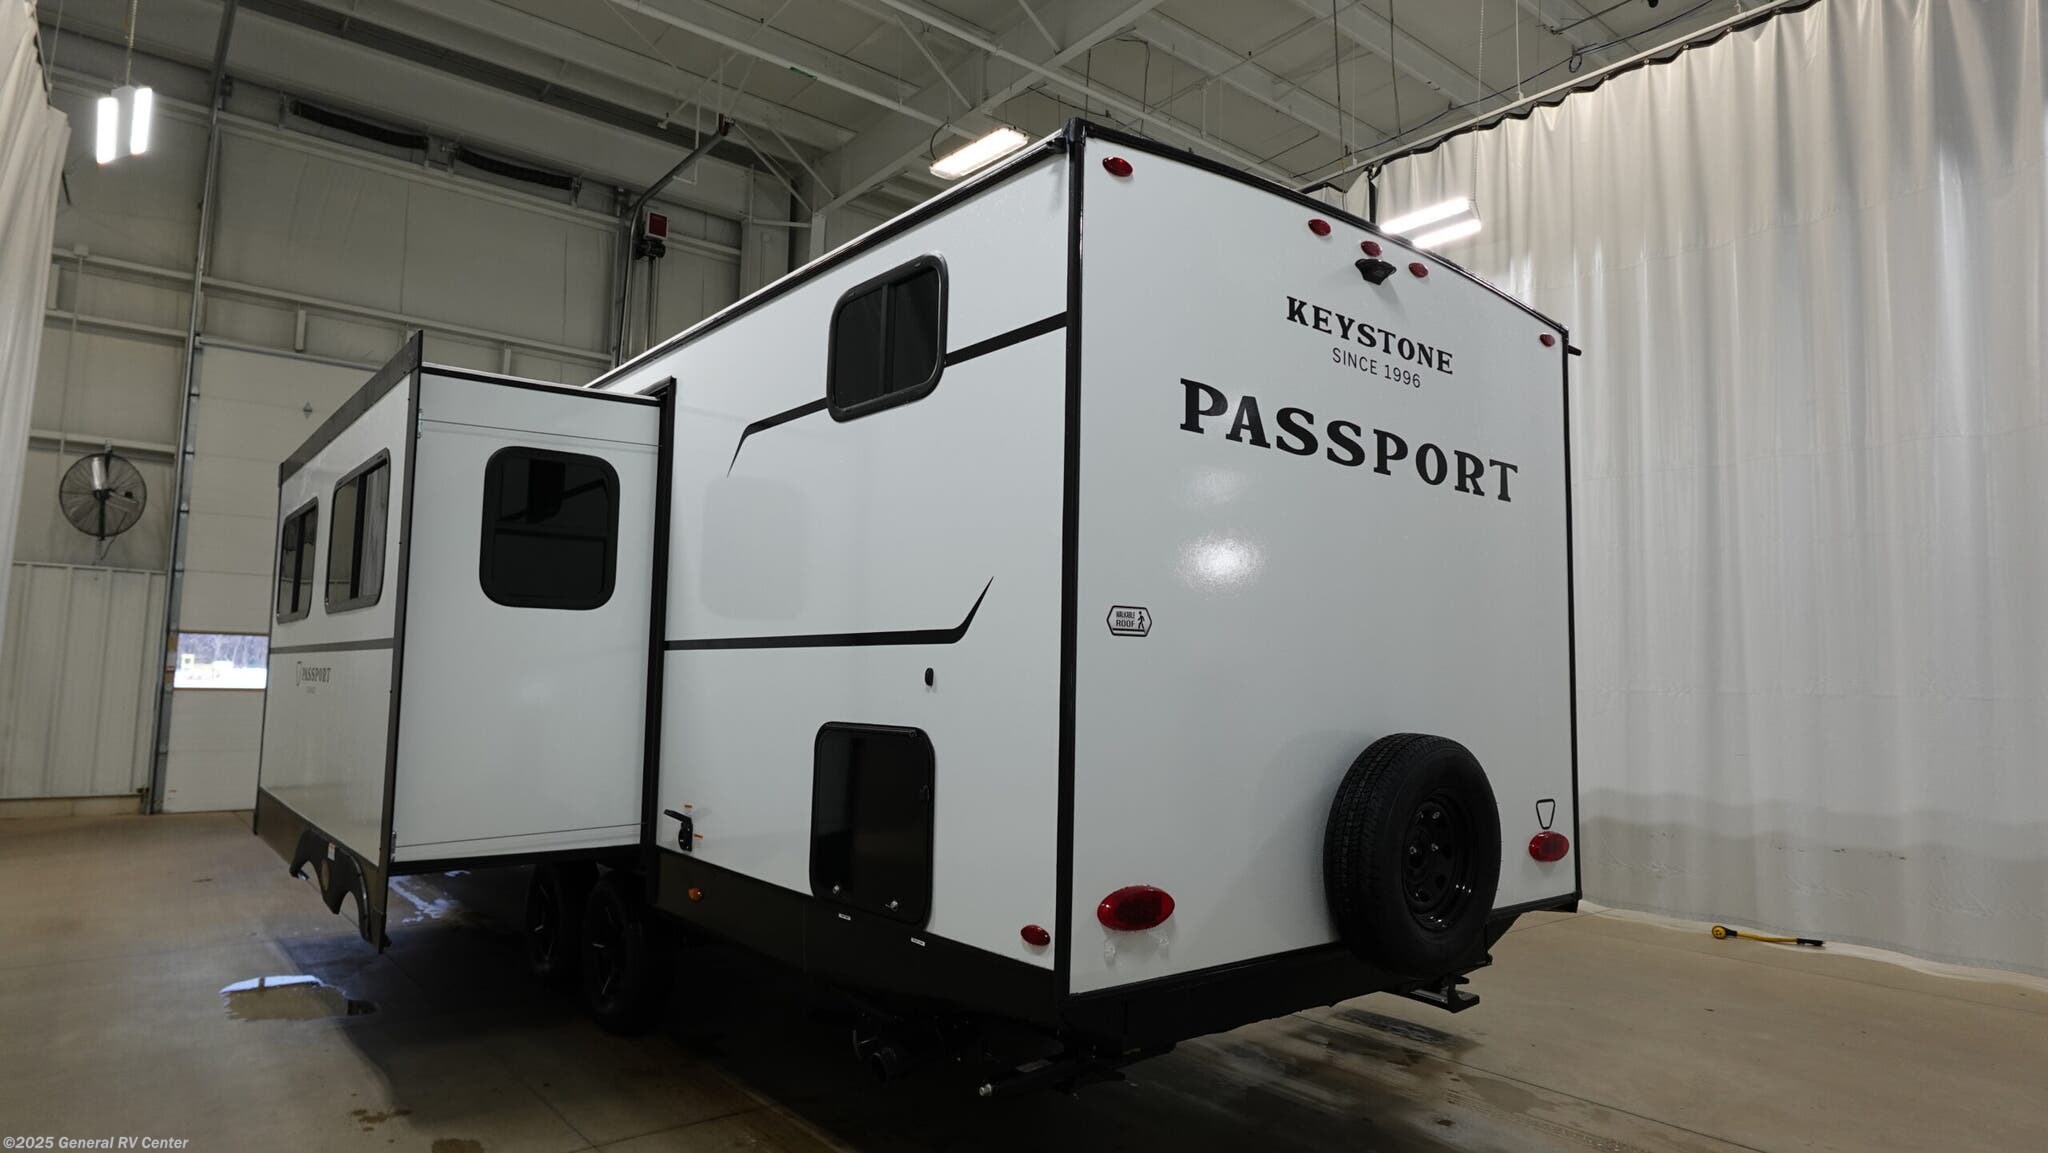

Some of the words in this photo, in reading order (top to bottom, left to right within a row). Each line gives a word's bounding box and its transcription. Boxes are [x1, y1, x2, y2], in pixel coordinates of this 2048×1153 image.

[1286, 296, 1453, 374] KEYSTONE
[1332, 347, 1378, 375] SINCE
[1384, 364, 1421, 389] 1996
[1180, 378, 1518, 502] PASSPORT
[302, 667, 332, 683] PASSPORT
